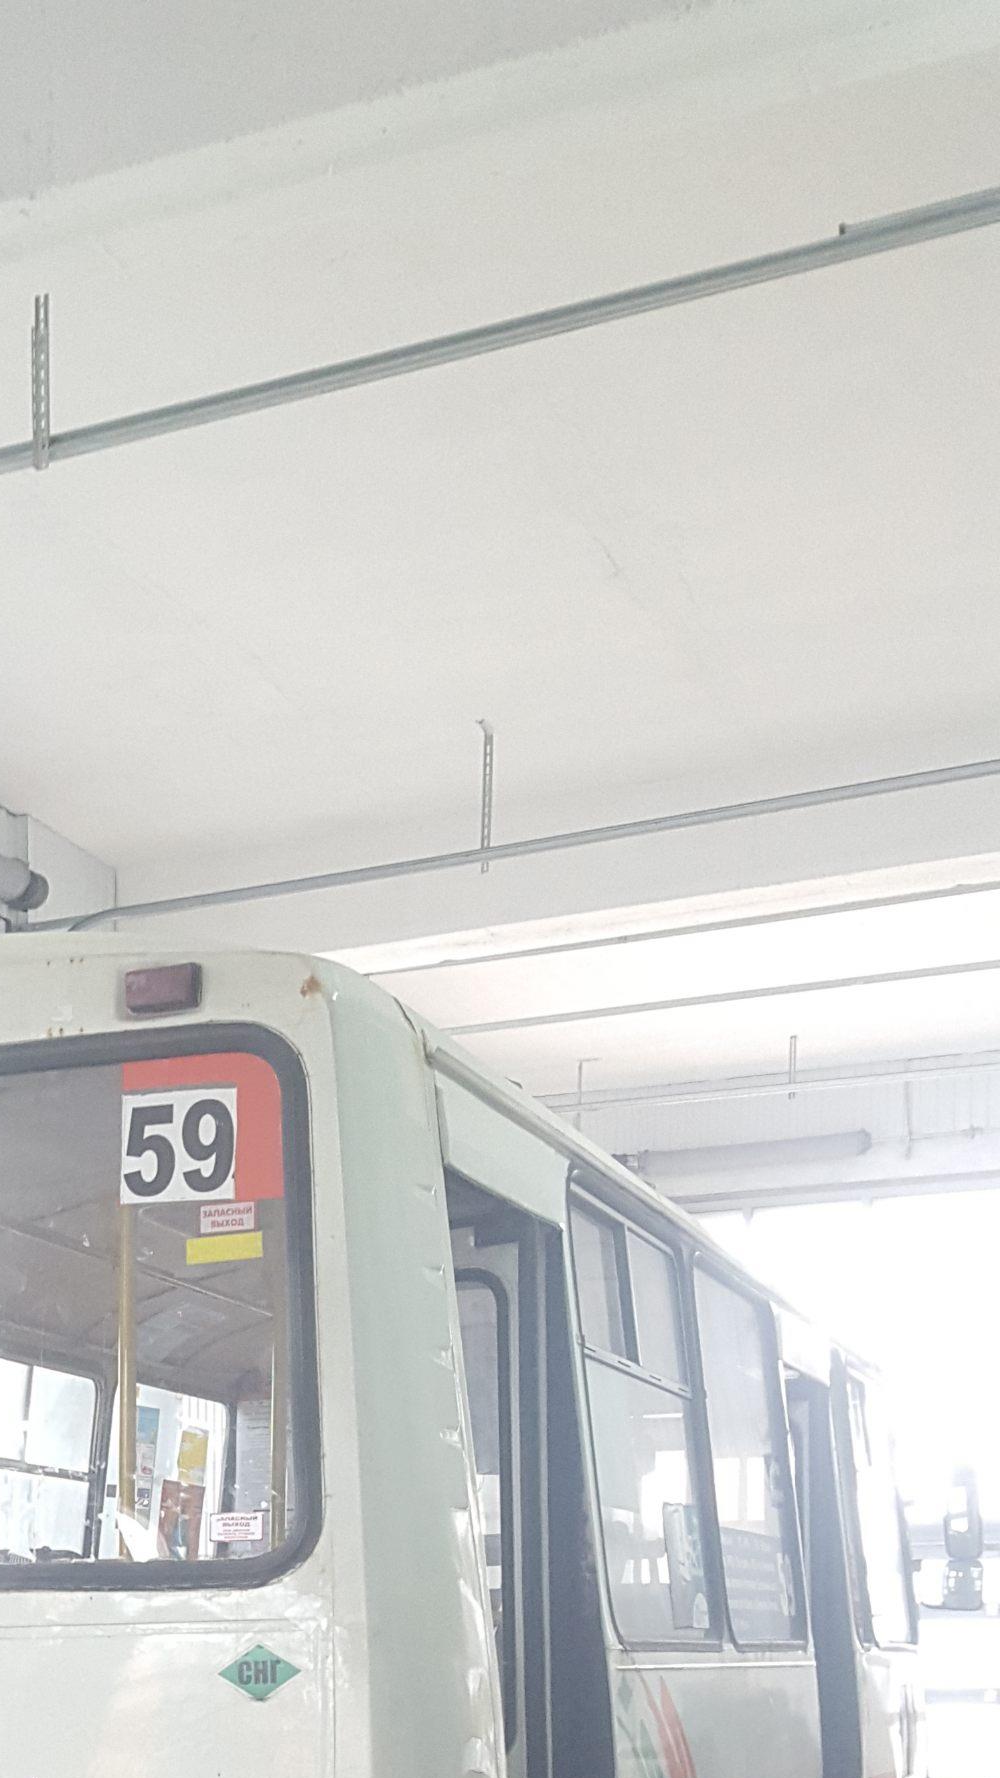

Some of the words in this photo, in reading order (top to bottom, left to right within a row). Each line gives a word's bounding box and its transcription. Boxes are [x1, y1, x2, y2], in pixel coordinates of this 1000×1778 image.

[123, 1098, 234, 1197] 59
[202, 1206, 253, 1218] ЗАПАСНЫЙ
[210, 1218, 244, 1228] ВЫХОД
[237, 1660, 281, 1686] СНГ
